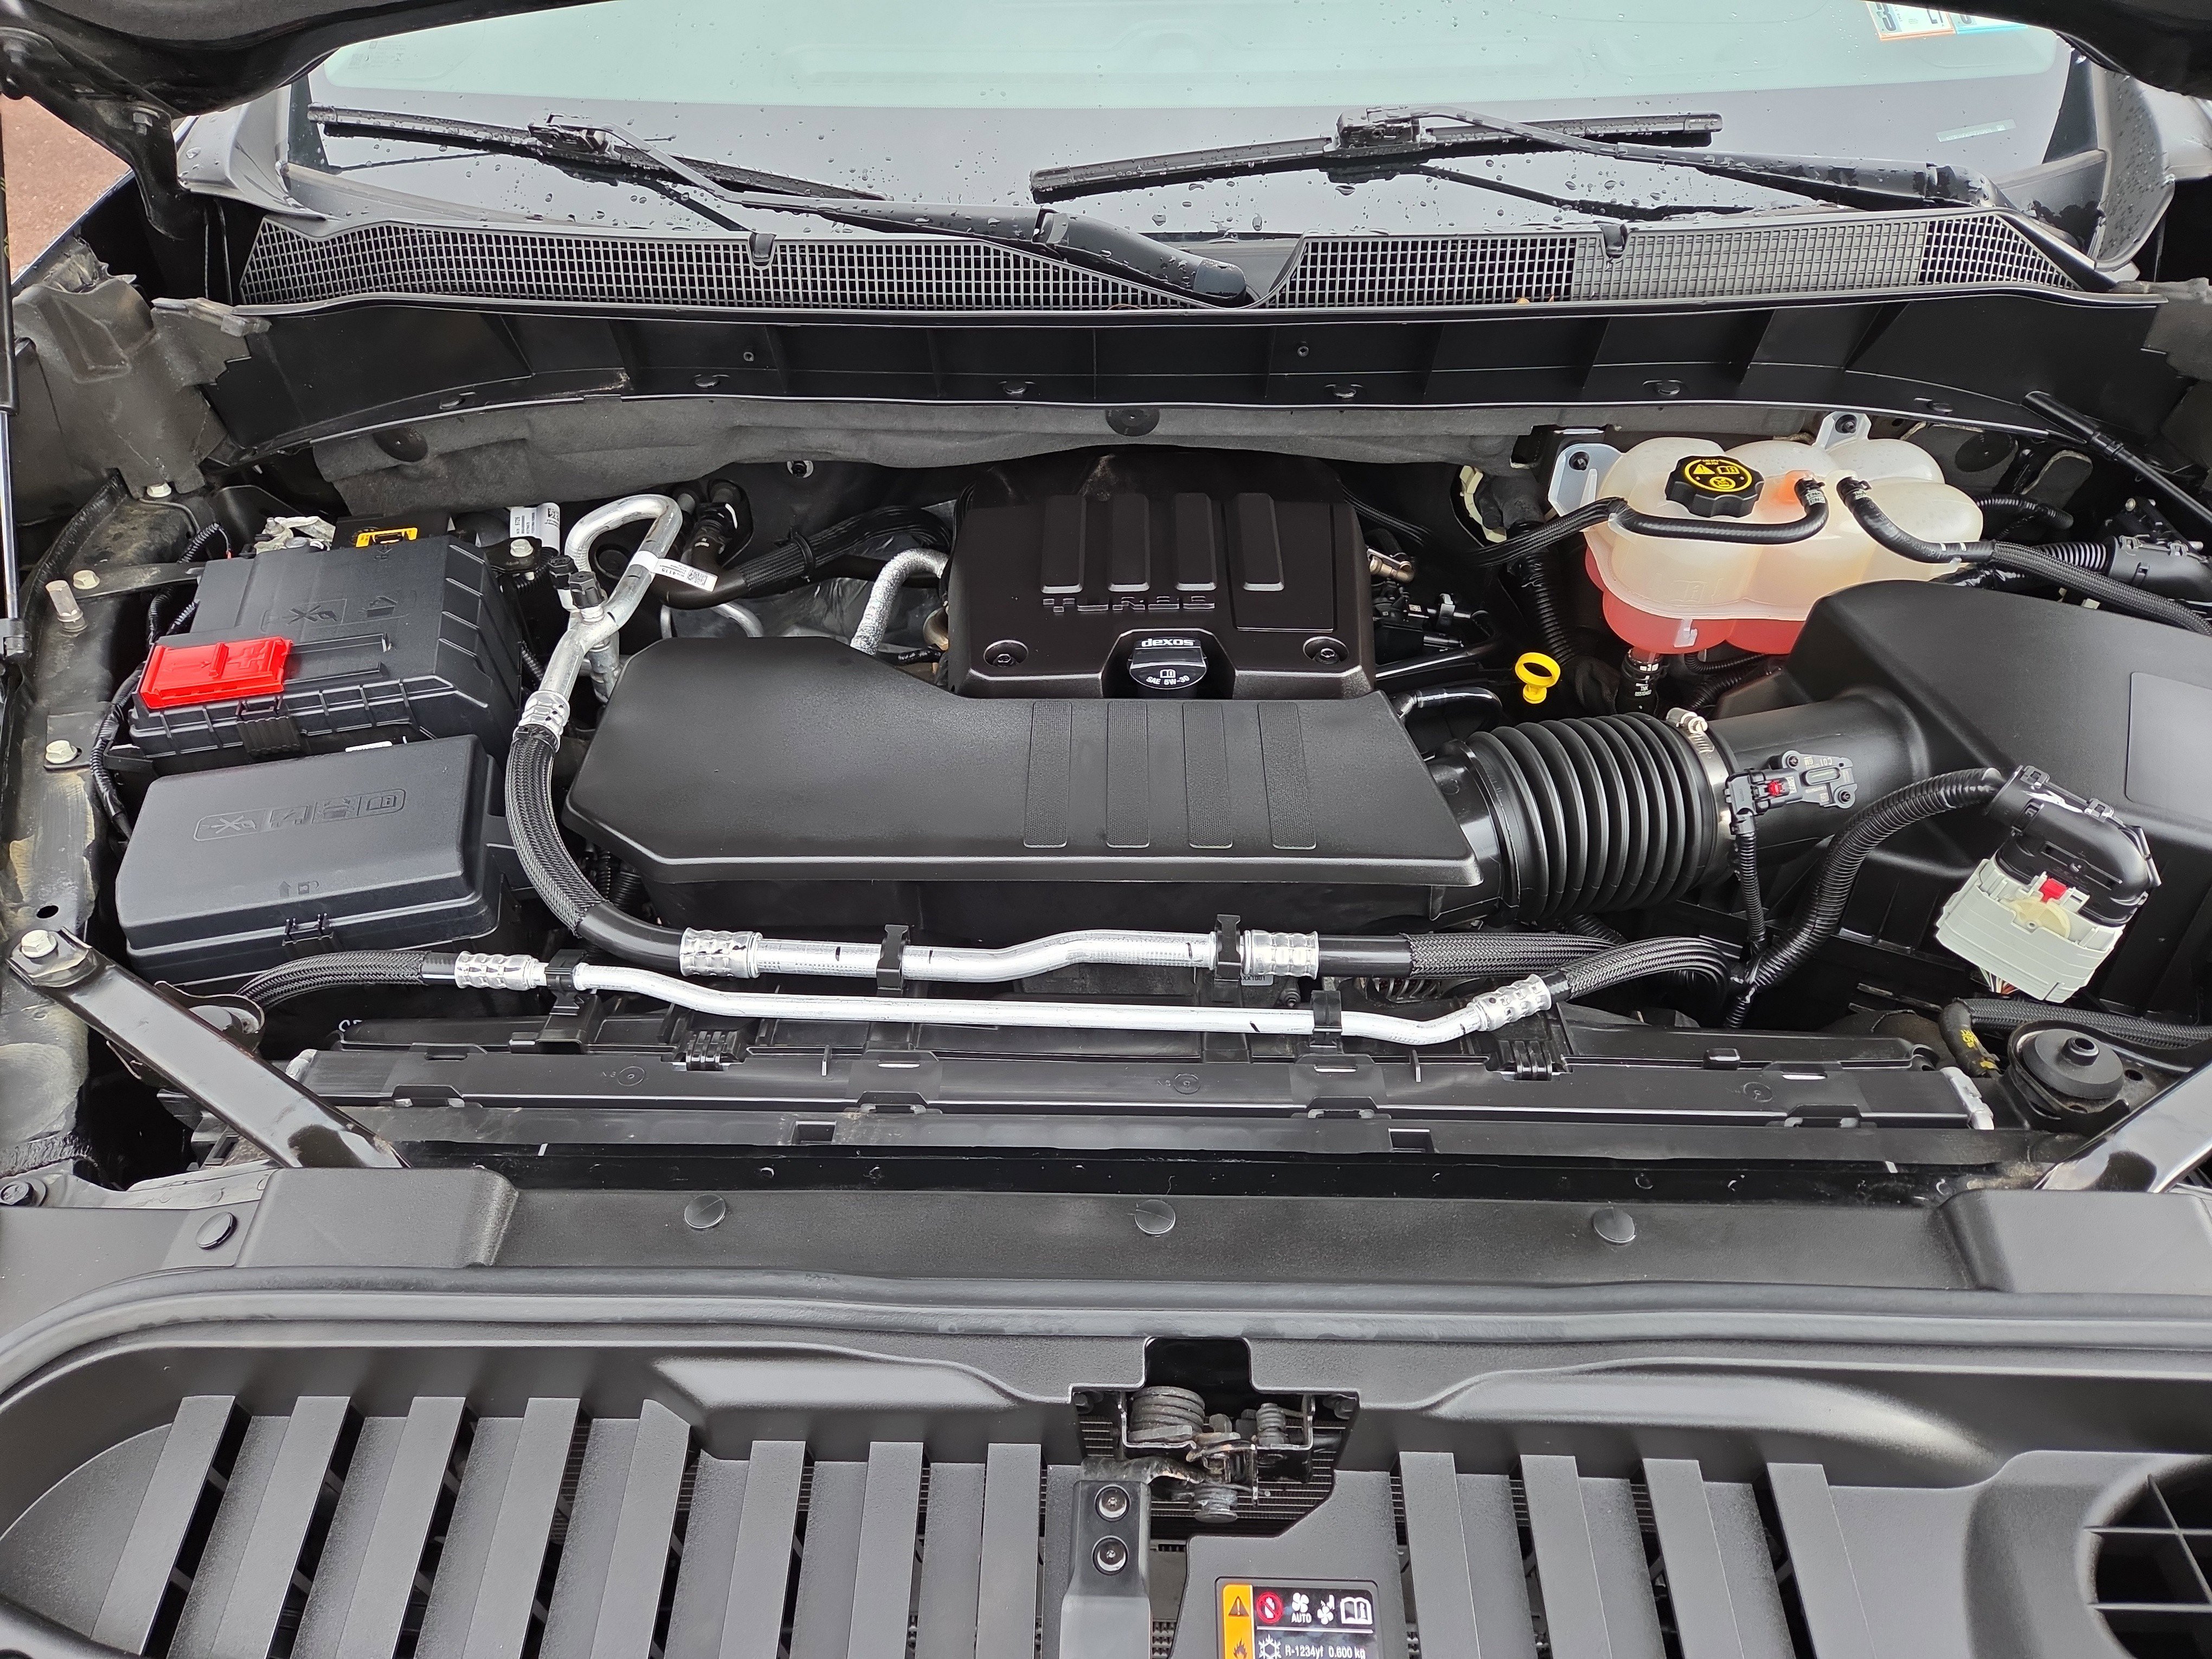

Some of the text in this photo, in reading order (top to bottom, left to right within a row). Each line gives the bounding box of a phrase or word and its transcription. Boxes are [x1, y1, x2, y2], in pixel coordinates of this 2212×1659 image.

[1141, 638, 1195, 647] dexos
[1146, 675, 1190, 685] SAE 5W-30
[1291, 1612, 1312, 1624] AUTO
[1285, 1644, 1366, 1659] R-1234yf 0.600 kg
